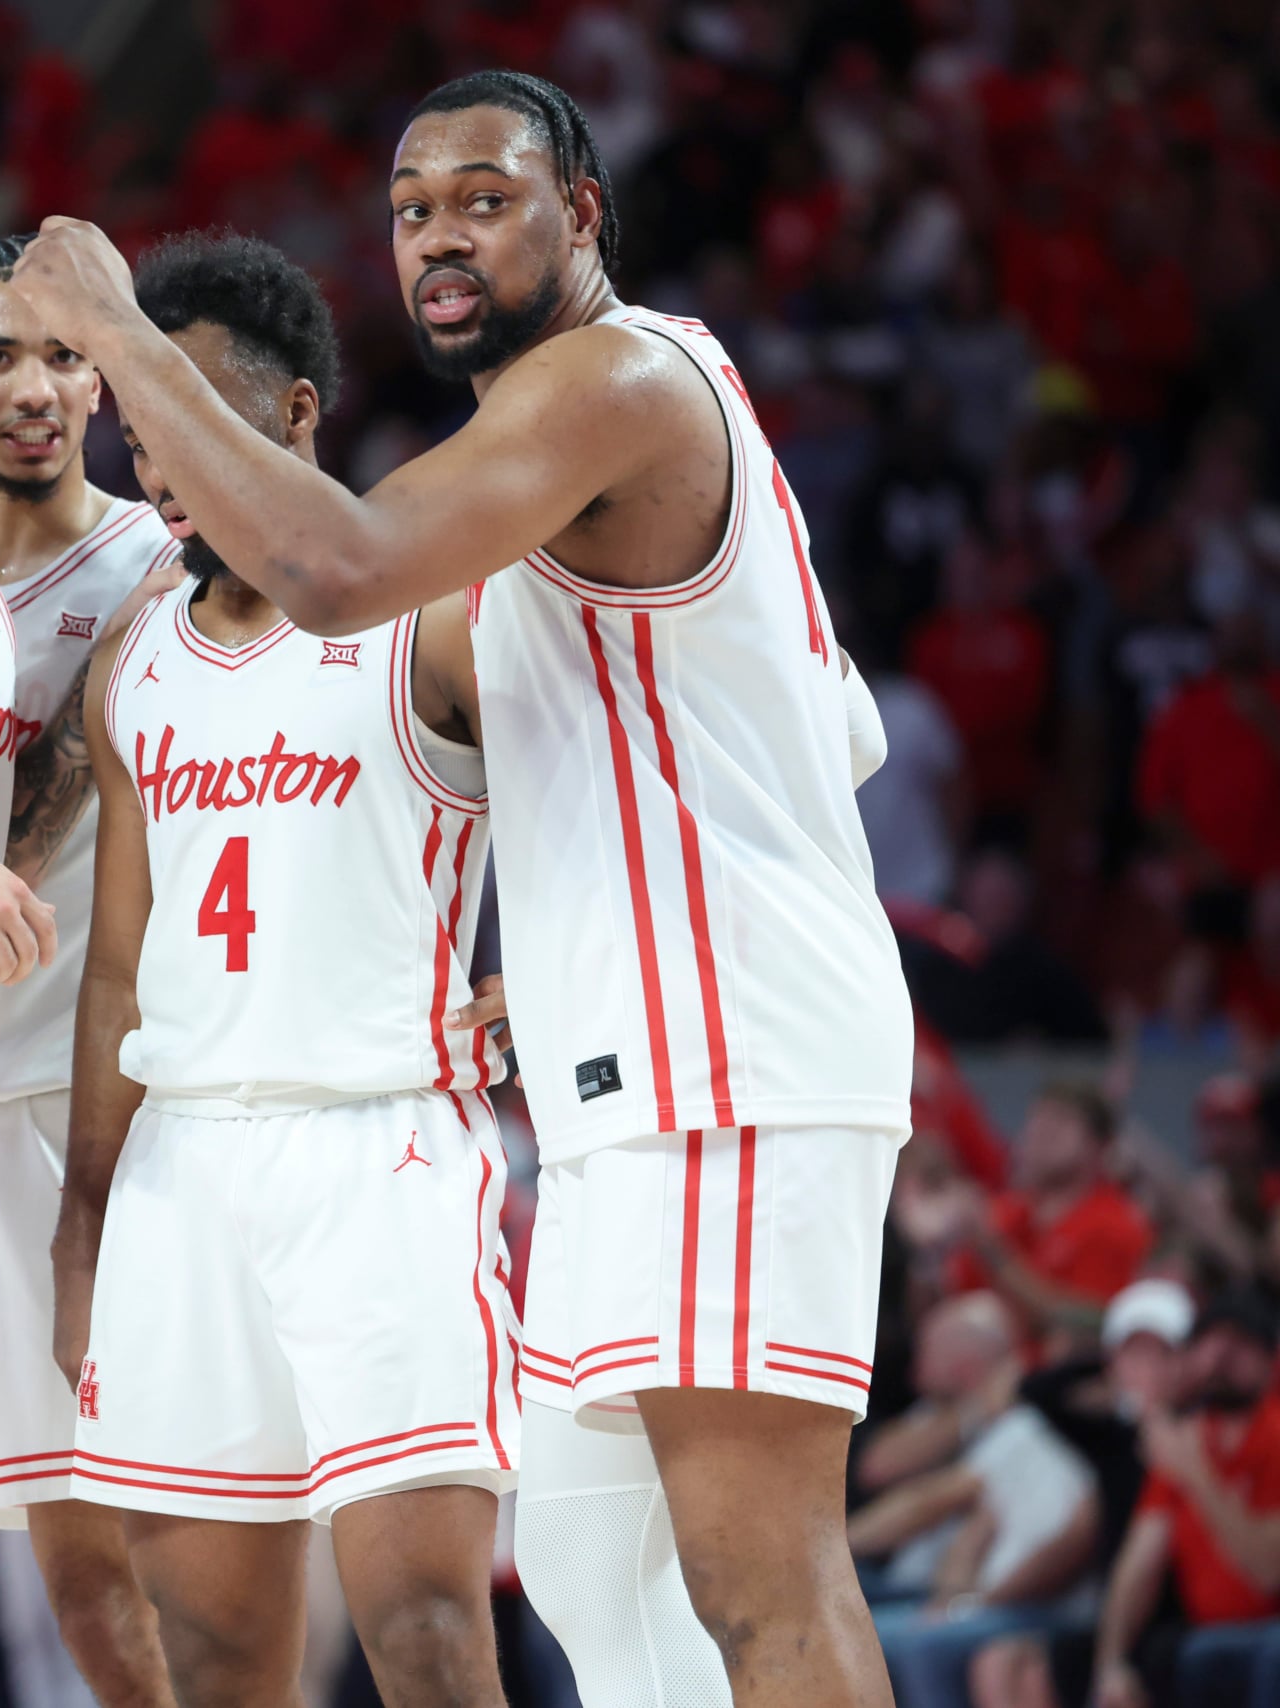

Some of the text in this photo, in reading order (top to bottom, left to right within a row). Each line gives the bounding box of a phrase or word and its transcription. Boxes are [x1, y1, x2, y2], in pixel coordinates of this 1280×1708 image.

[323, 643, 358, 666] XII
[135, 724, 361, 827] Houston
[198, 837, 256, 972] 4
[599, 1066, 612, 1082] XL
